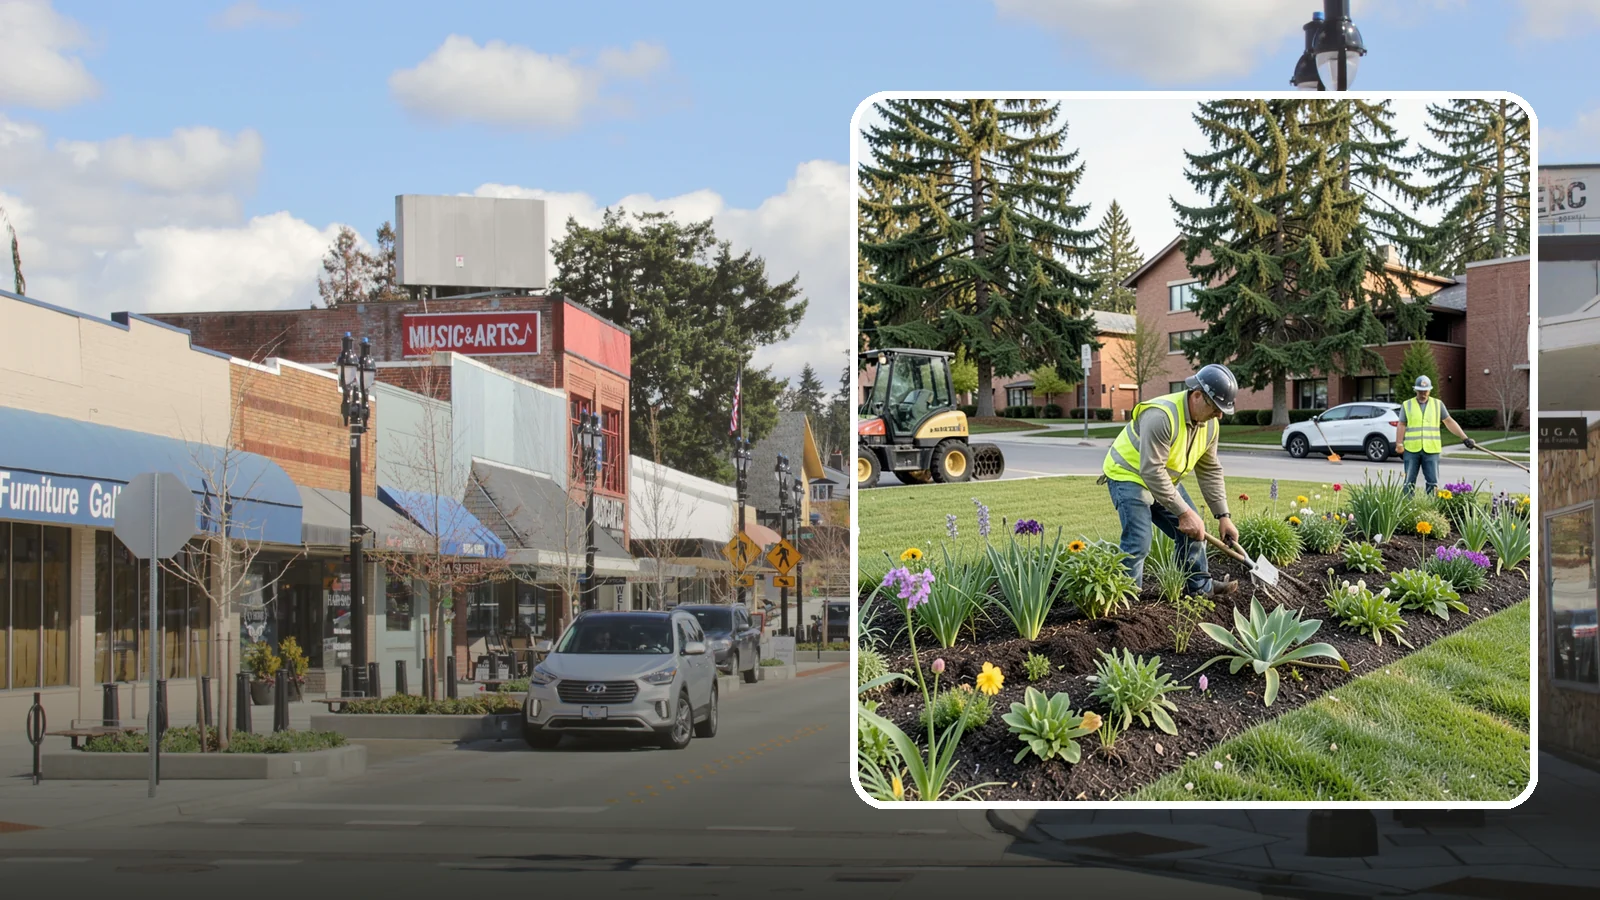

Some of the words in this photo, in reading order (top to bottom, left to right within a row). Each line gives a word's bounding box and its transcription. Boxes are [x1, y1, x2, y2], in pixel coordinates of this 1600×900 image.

[0, 471, 80, 515] Furniture
[89, 482, 121, 519] Gal
[453, 563, 479, 574] SUSHI
